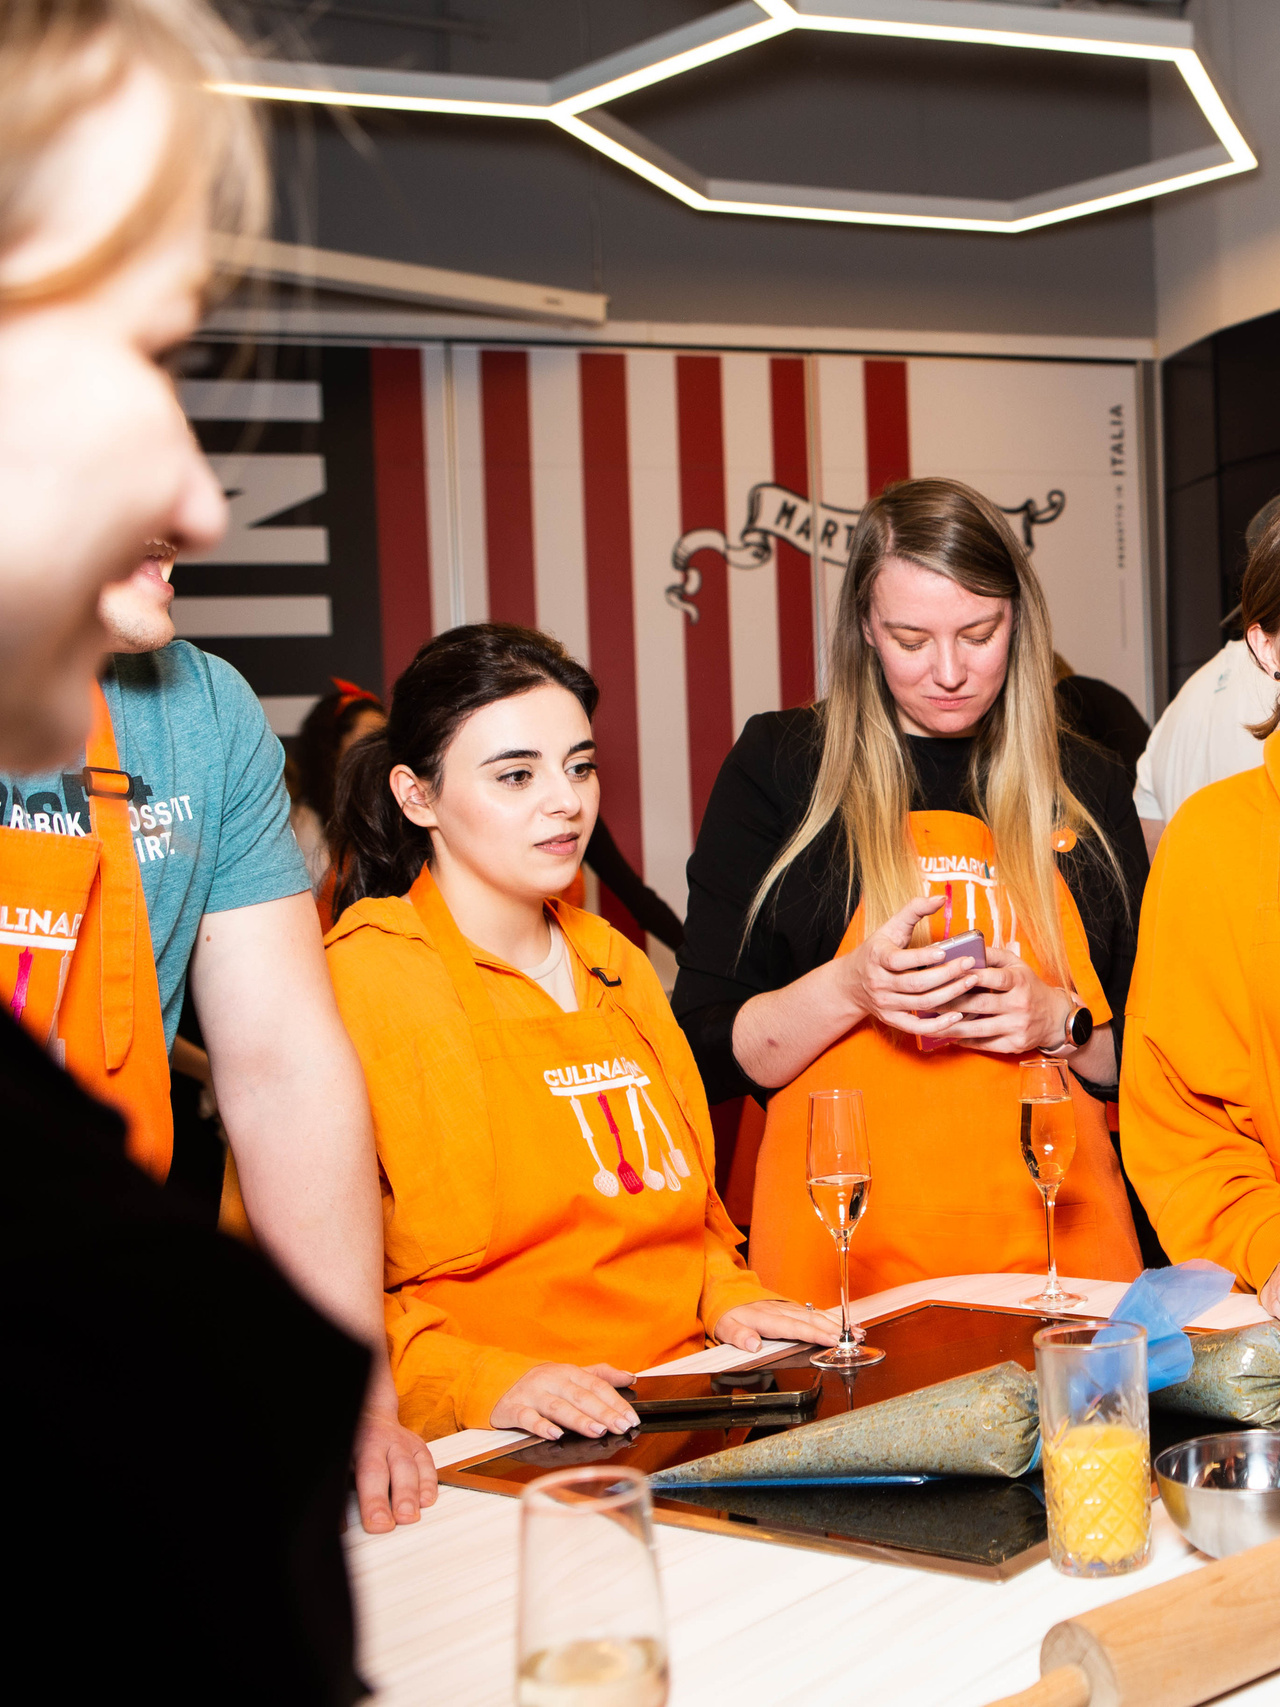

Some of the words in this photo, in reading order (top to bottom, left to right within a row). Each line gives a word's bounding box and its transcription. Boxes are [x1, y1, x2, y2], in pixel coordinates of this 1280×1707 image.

[1109, 404, 1125, 477] ITALIA
[774, 500, 856, 552] MART
[918, 855, 985, 876] ULINARY
